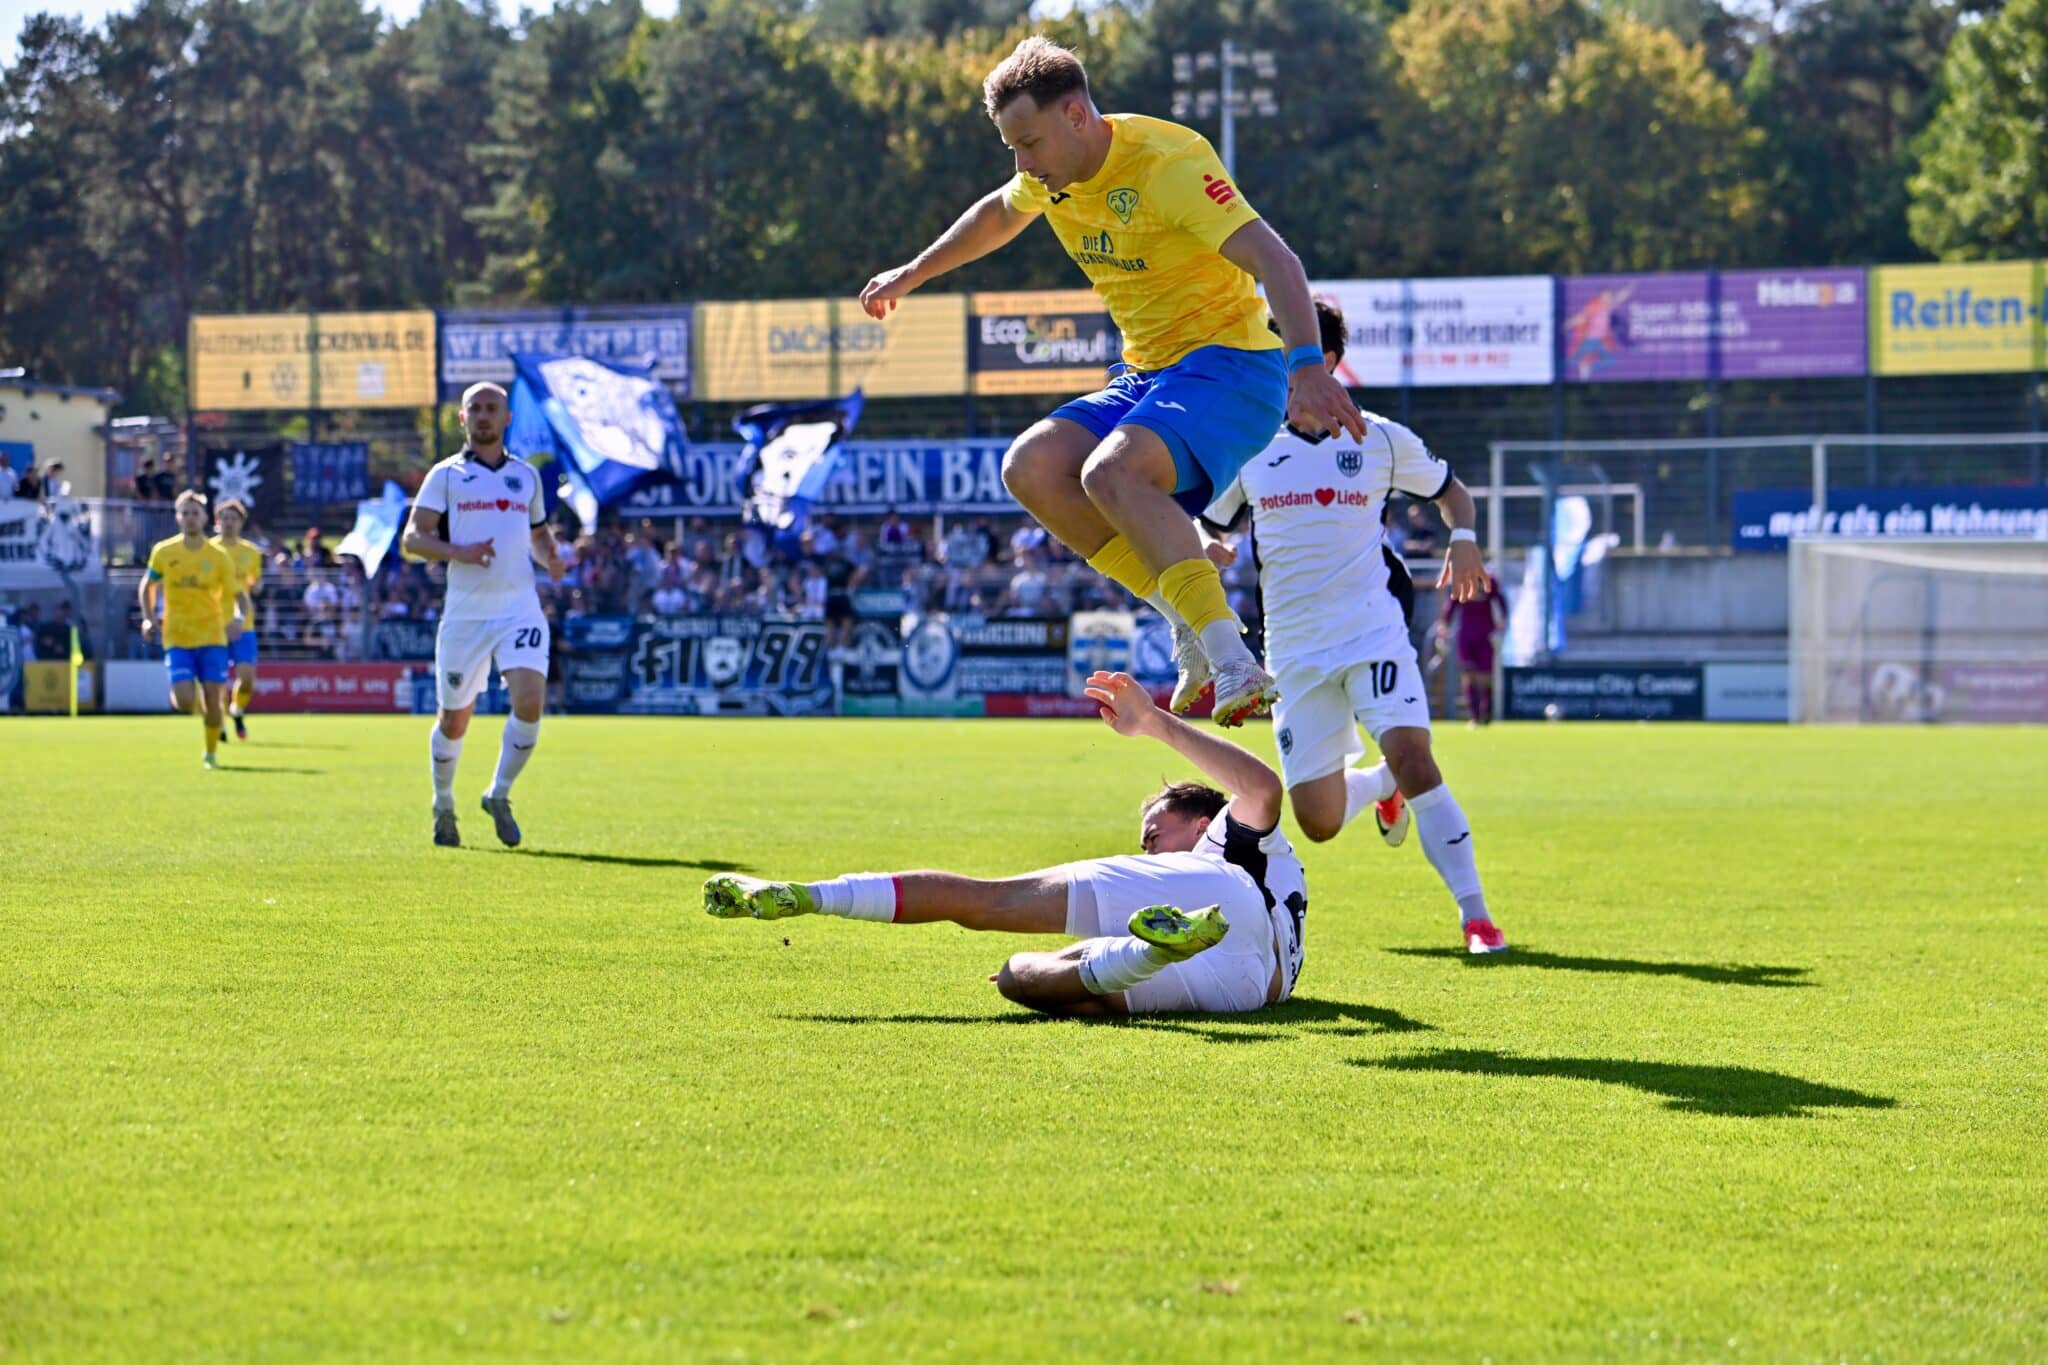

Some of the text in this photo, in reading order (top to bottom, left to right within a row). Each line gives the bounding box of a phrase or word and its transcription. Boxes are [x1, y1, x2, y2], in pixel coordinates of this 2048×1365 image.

[1083, 236, 1098, 251] DIE
[1891, 287, 2048, 330] Reifen-
[1260, 489, 1370, 511] Potsdam Liebe
[514, 627, 542, 649] 20
[1370, 660, 1397, 698] 10
